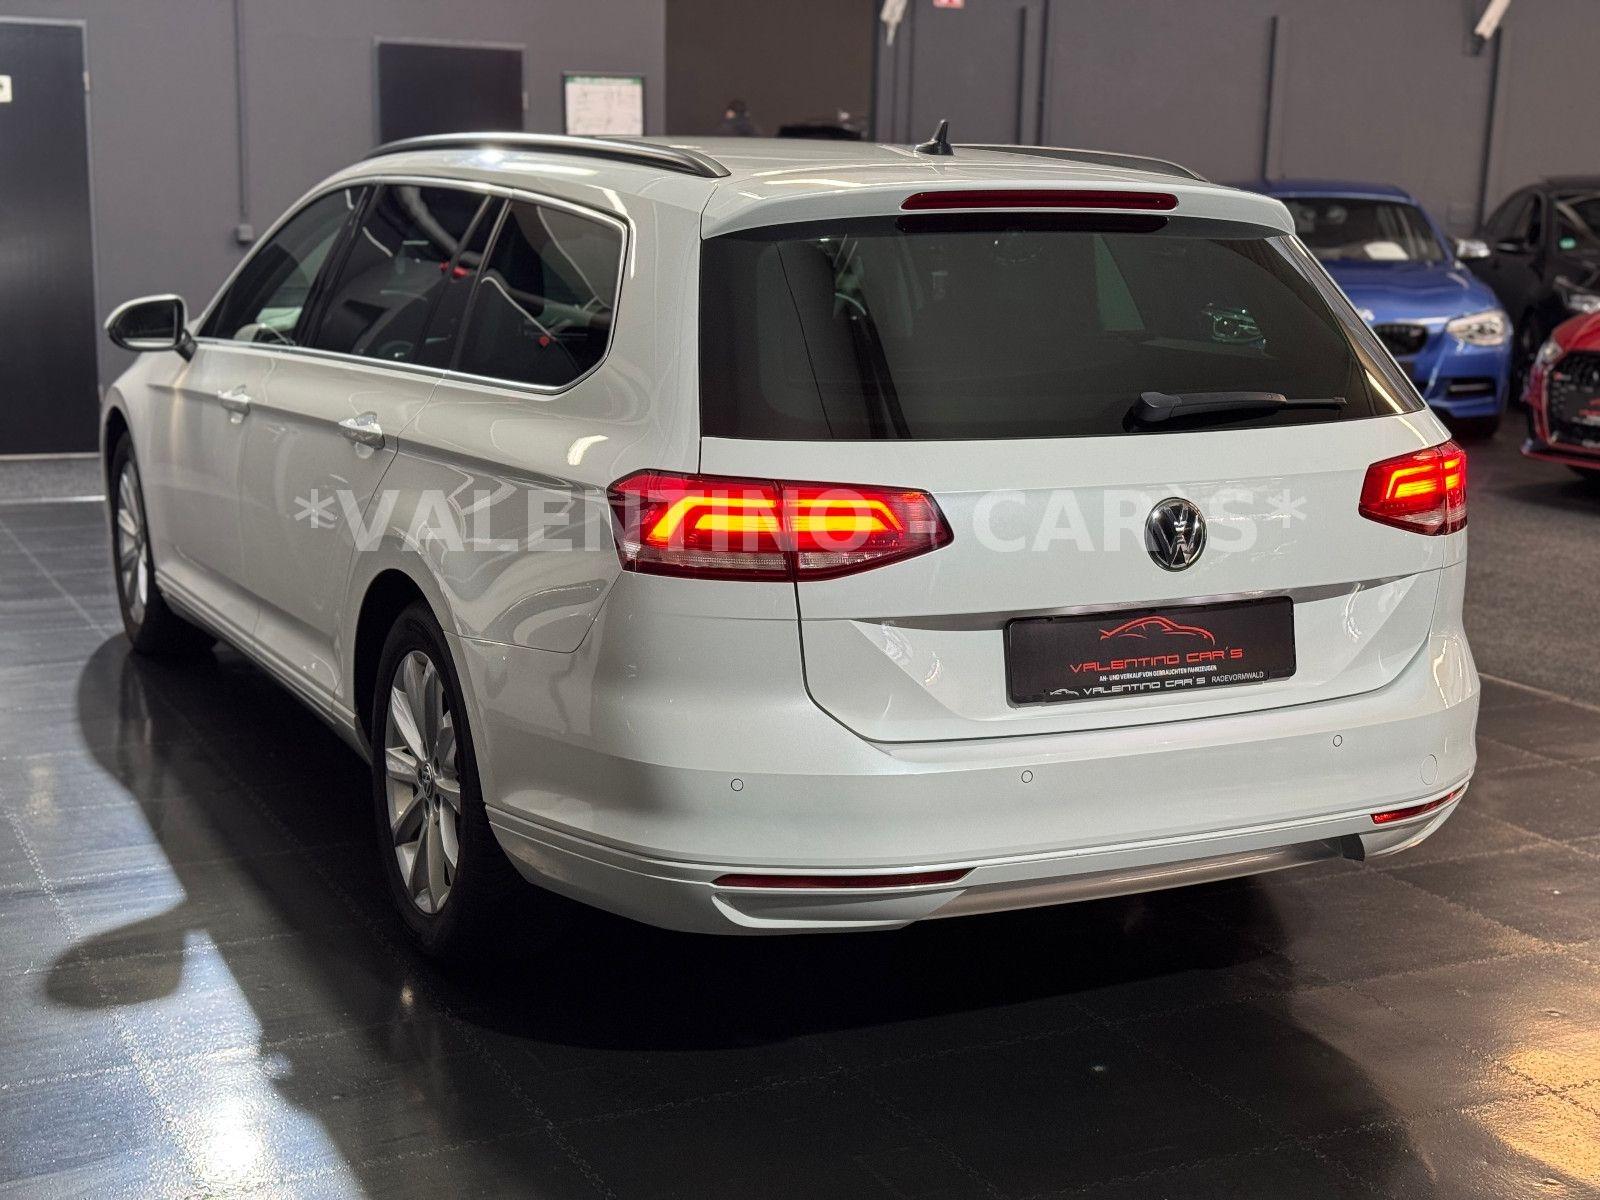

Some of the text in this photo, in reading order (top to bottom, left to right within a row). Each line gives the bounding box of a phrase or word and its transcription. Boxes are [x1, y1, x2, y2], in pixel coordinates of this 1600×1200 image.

[1069, 654, 1180, 673] VALENTINO
[1083, 681, 1161, 696] VALENTINO
[1211, 671, 1265, 684] RADEVORMWALD
[1120, 671, 1142, 680] VERKAUF
[1142, 670, 1153, 678] VON
